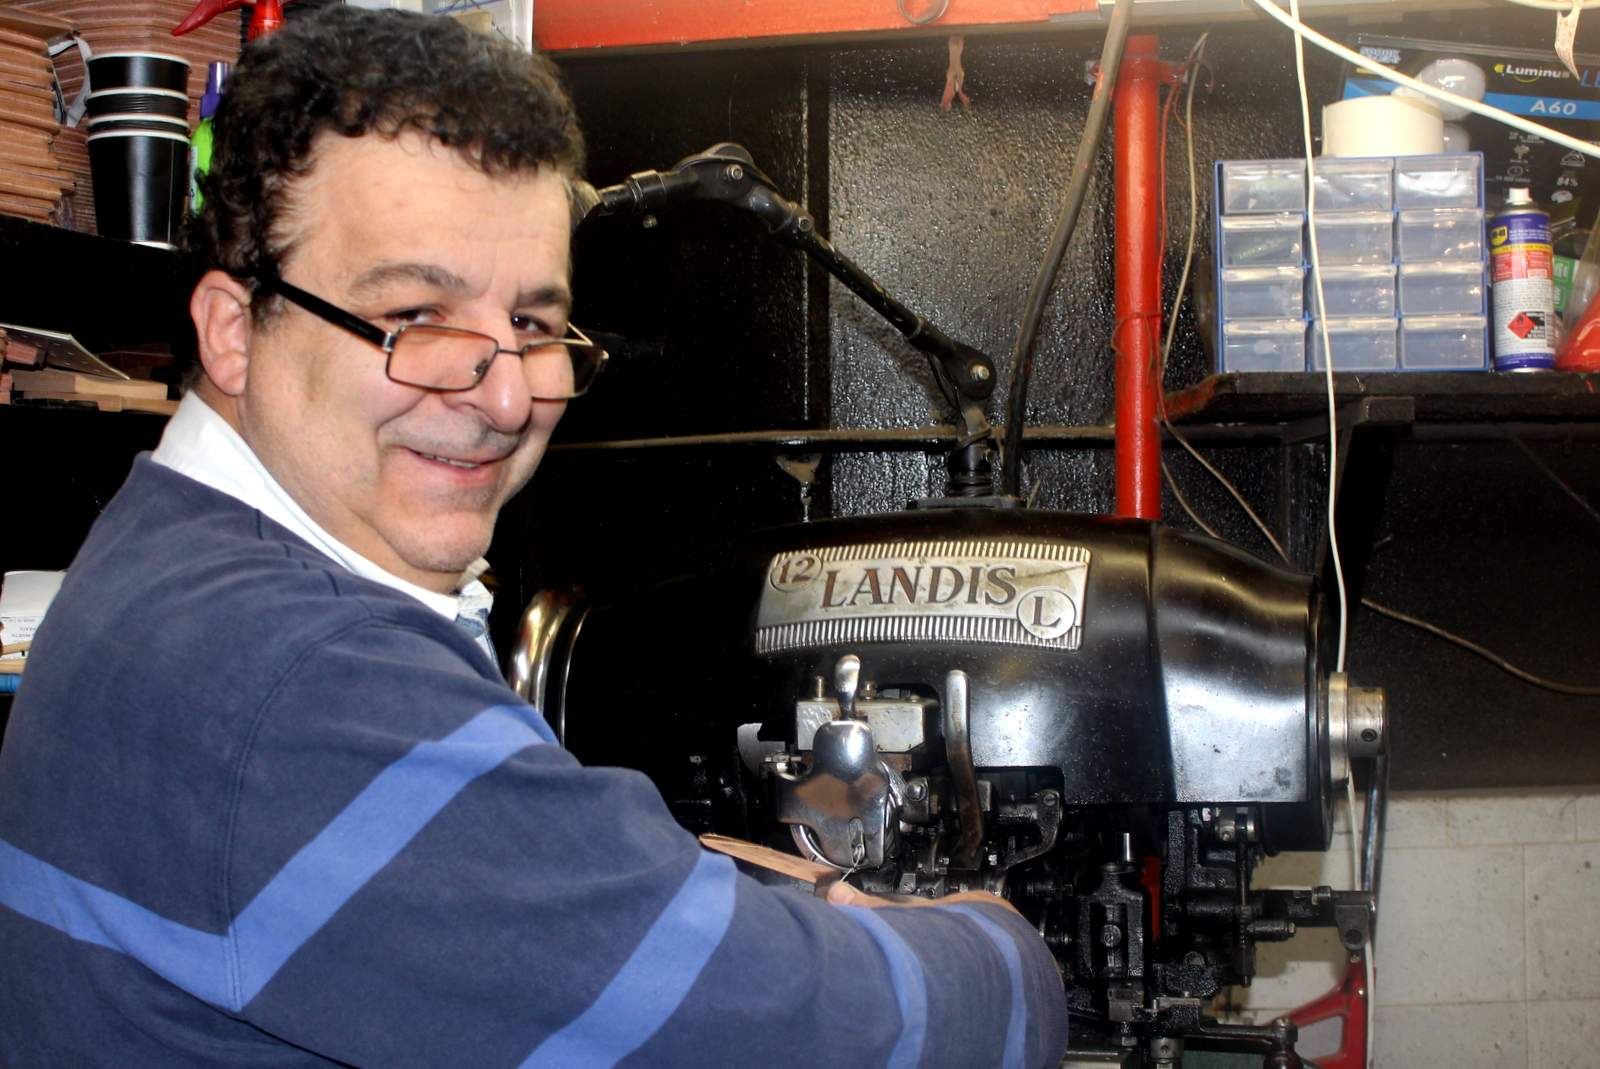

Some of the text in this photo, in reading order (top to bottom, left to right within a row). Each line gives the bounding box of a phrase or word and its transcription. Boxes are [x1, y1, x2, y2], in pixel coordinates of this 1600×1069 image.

[1531, 100, 1577, 116] A60
[777, 558, 813, 585] 12
[820, 565, 1018, 609] LANDIS
[1030, 596, 1061, 628] L
